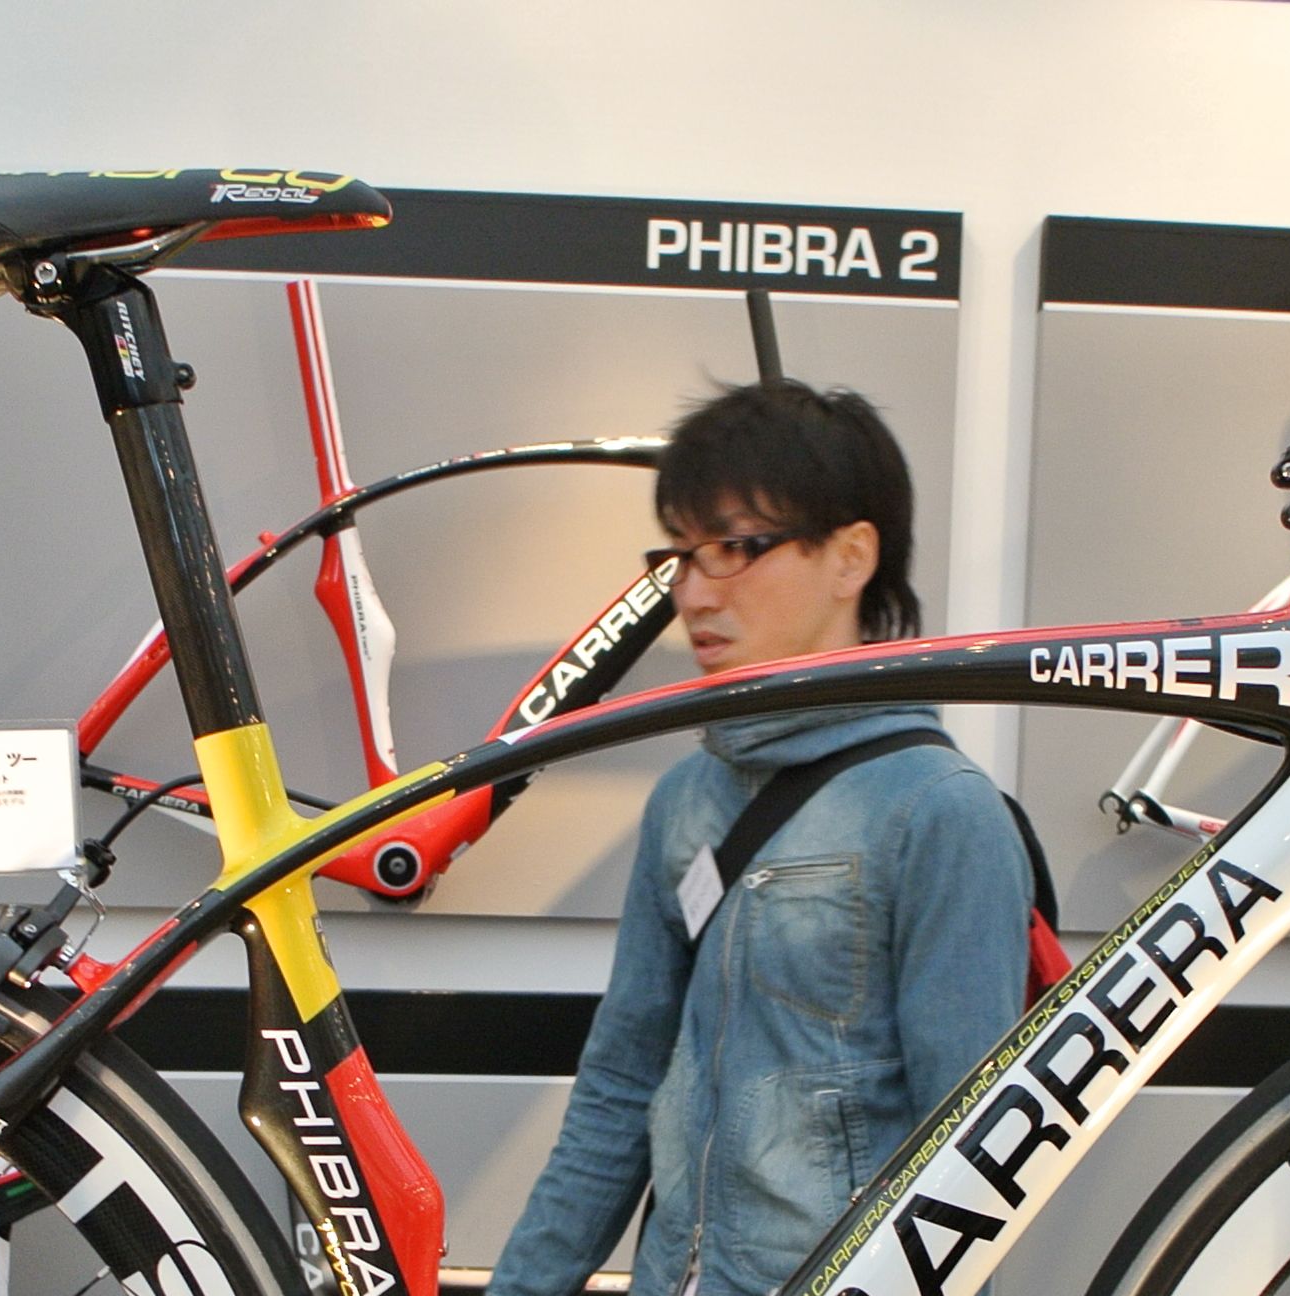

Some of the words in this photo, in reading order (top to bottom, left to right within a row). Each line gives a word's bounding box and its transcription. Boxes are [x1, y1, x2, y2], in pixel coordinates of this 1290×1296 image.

[647, 218, 882, 280] PHIBRA
[899, 231, 940, 282] 2
[116, 301, 147, 383] RITCHEY
[6, 751, 38, 768] ツー
[888, 1105, 962, 1201] CARBON
[996, 999, 1060, 1071] BLOCK
[1058, 923, 1134, 1005] SYSTEM
[1133, 843, 1219, 928] PROJECT
